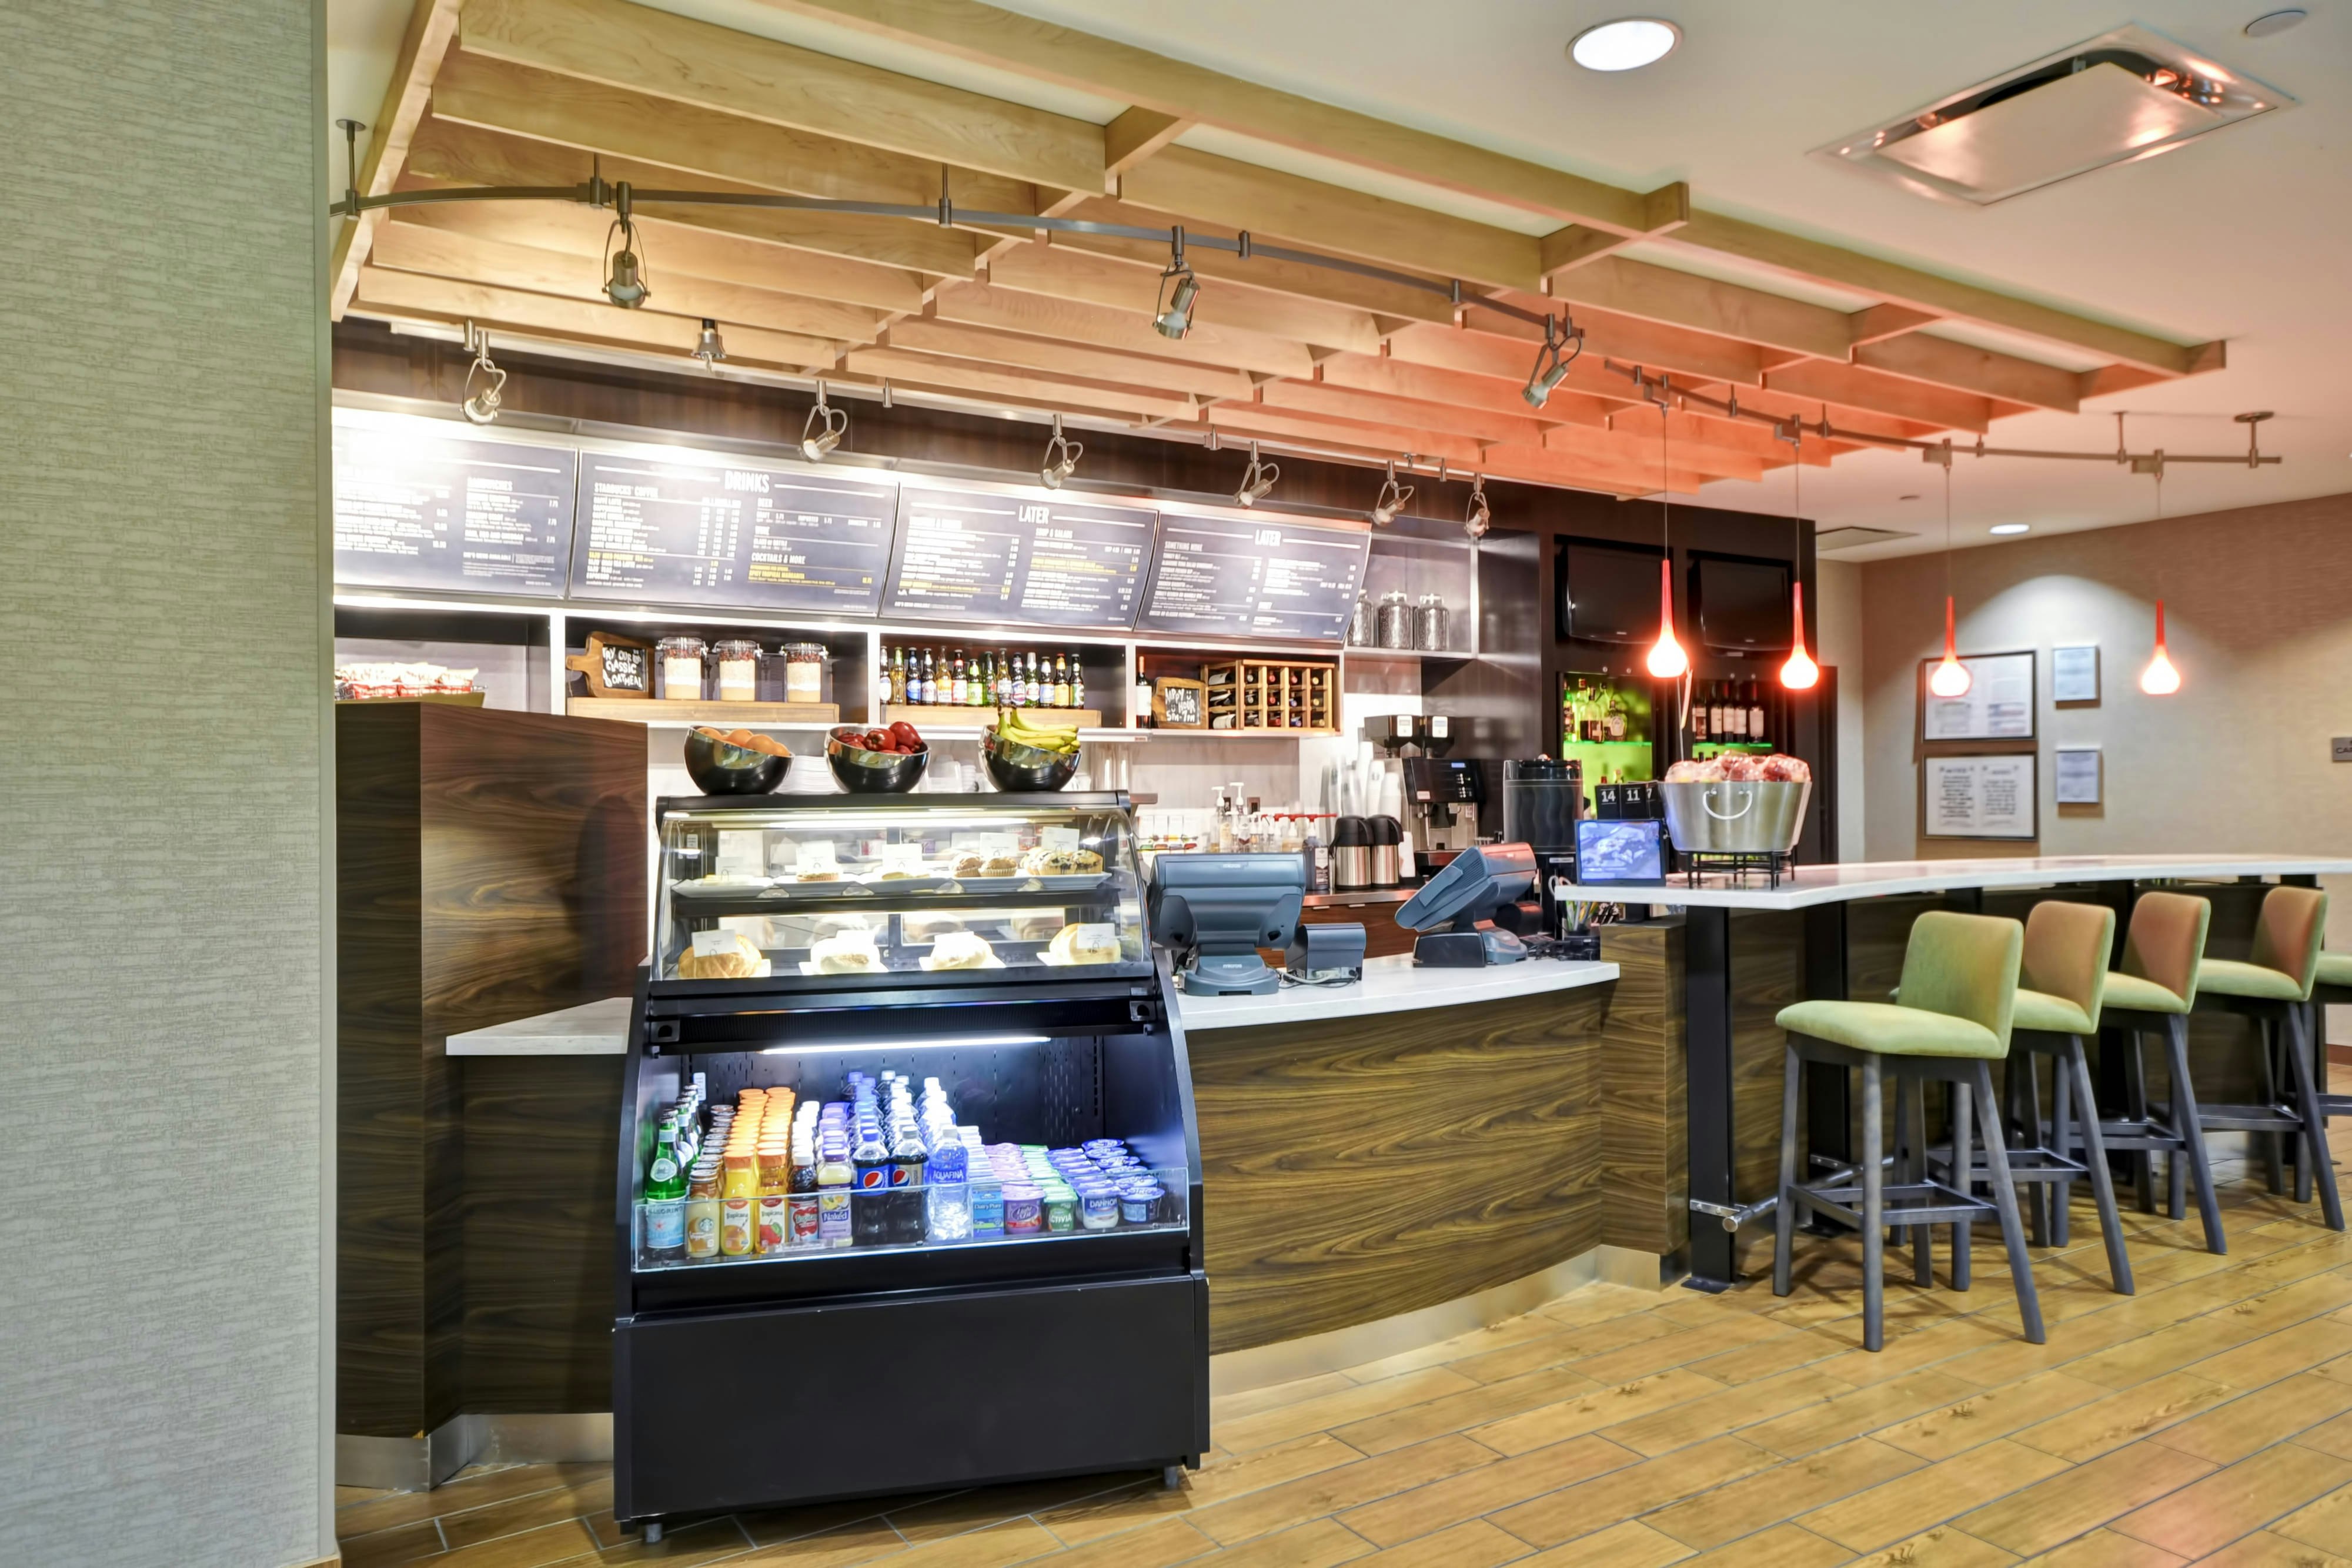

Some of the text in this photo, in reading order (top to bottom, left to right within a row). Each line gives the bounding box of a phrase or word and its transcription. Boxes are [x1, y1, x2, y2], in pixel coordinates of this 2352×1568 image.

[724, 470, 770, 493] DRINKS
[1018, 504, 1050, 524] LATER
[1254, 529, 1281, 547] LATER
[751, 552, 782, 563] COCKTAILS
[790, 556, 806, 564] MORE
[602, 647, 632, 663] TRY OUR
[606, 659, 637, 674] CLASSIC
[612, 673, 643, 690] OATMEAL
[1178, 698, 1196, 714] HOUR
[1601, 790, 1616, 803] 14
[1627, 789, 1641, 801] 11
[933, 1169, 964, 1181] AQUAFINA
[1090, 1199, 1117, 1209] DANNON
[823, 1211, 847, 1221] Naked
